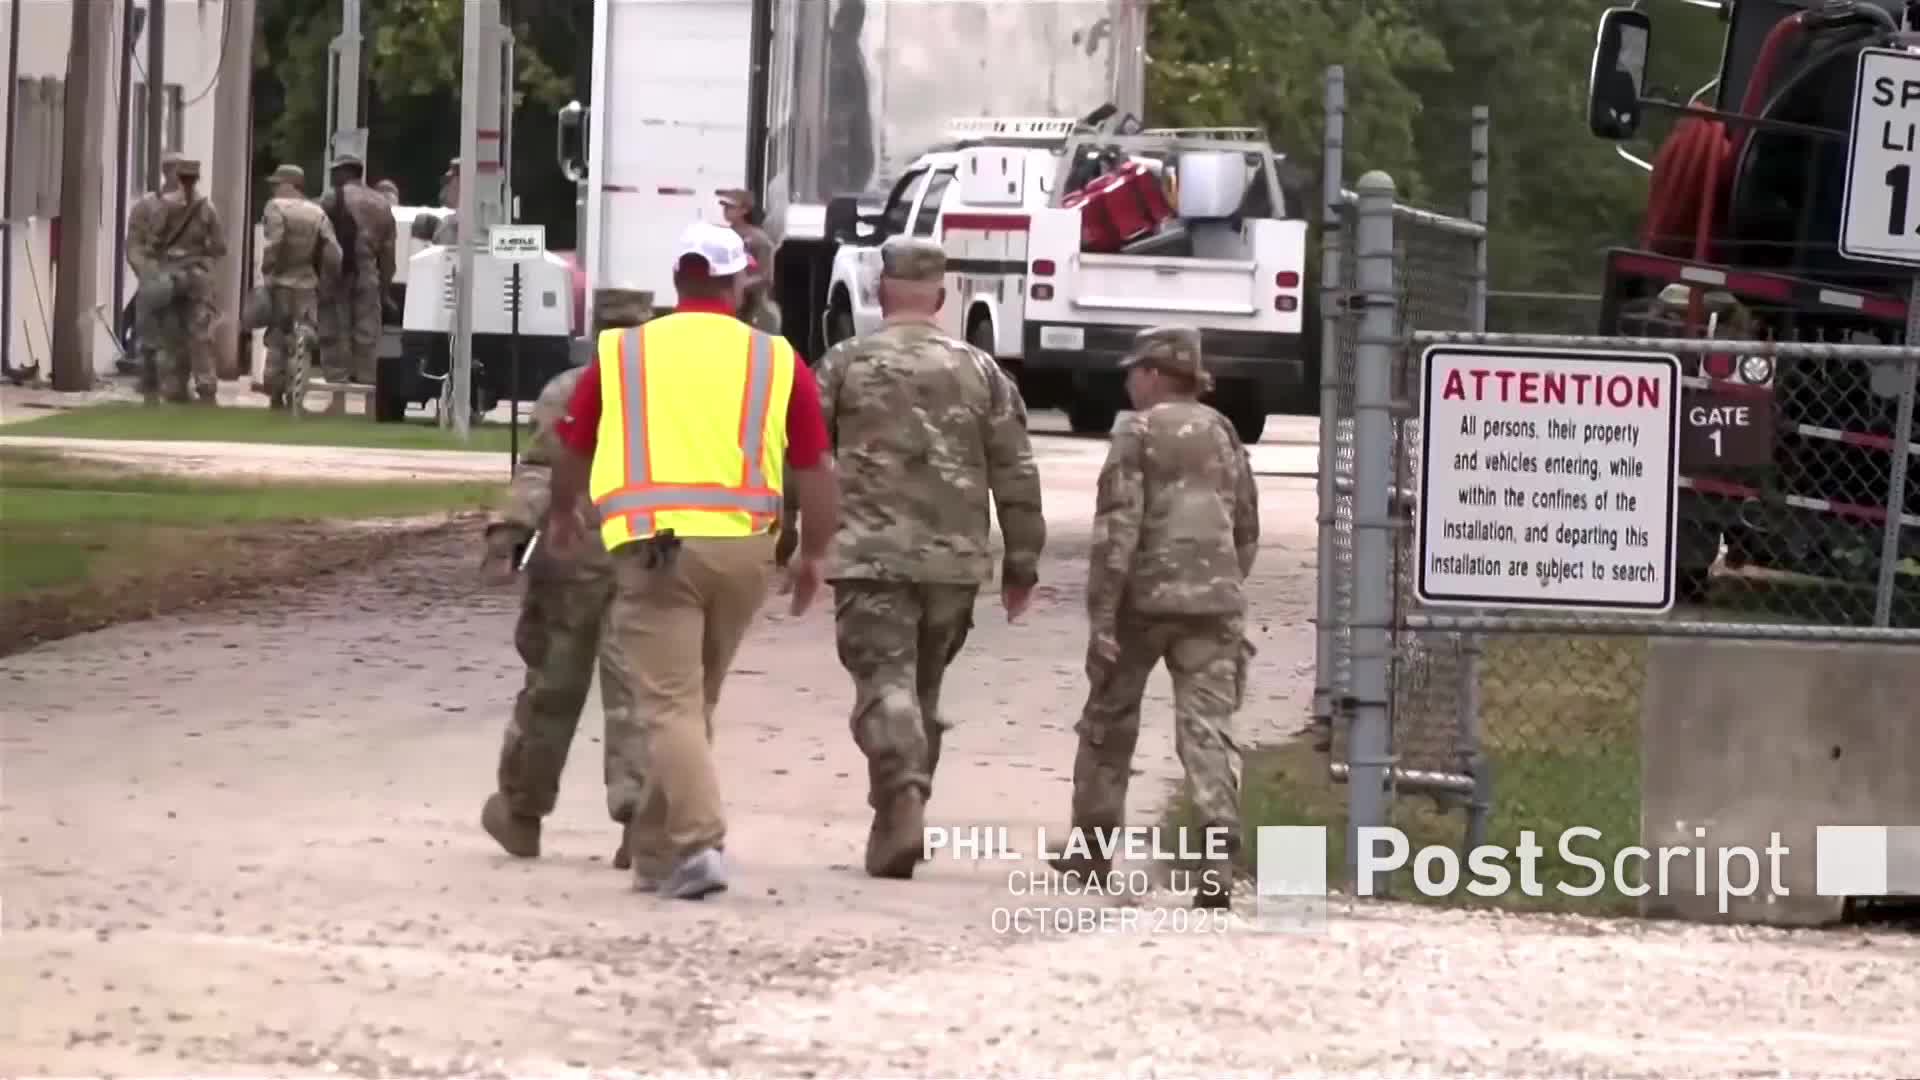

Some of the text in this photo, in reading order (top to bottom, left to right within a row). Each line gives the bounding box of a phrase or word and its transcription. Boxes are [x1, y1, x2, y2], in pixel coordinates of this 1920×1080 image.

[1884, 163, 1920, 236] 1
[1443, 368, 1660, 409] ATTENTION
[1460, 415, 1477, 436] All
[1548, 419, 1576, 439] their
[1583, 423, 1640, 445] property
[1689, 405, 1750, 426] GATE
[1708, 429, 1722, 457] 1
[1453, 451, 1643, 480] and vehicles entering, while
[1458, 485, 1637, 512] within the confines of the
[1443, 520, 1649, 550] installation, and departing this
[1431, 552, 1659, 584] installation are subject to search.
